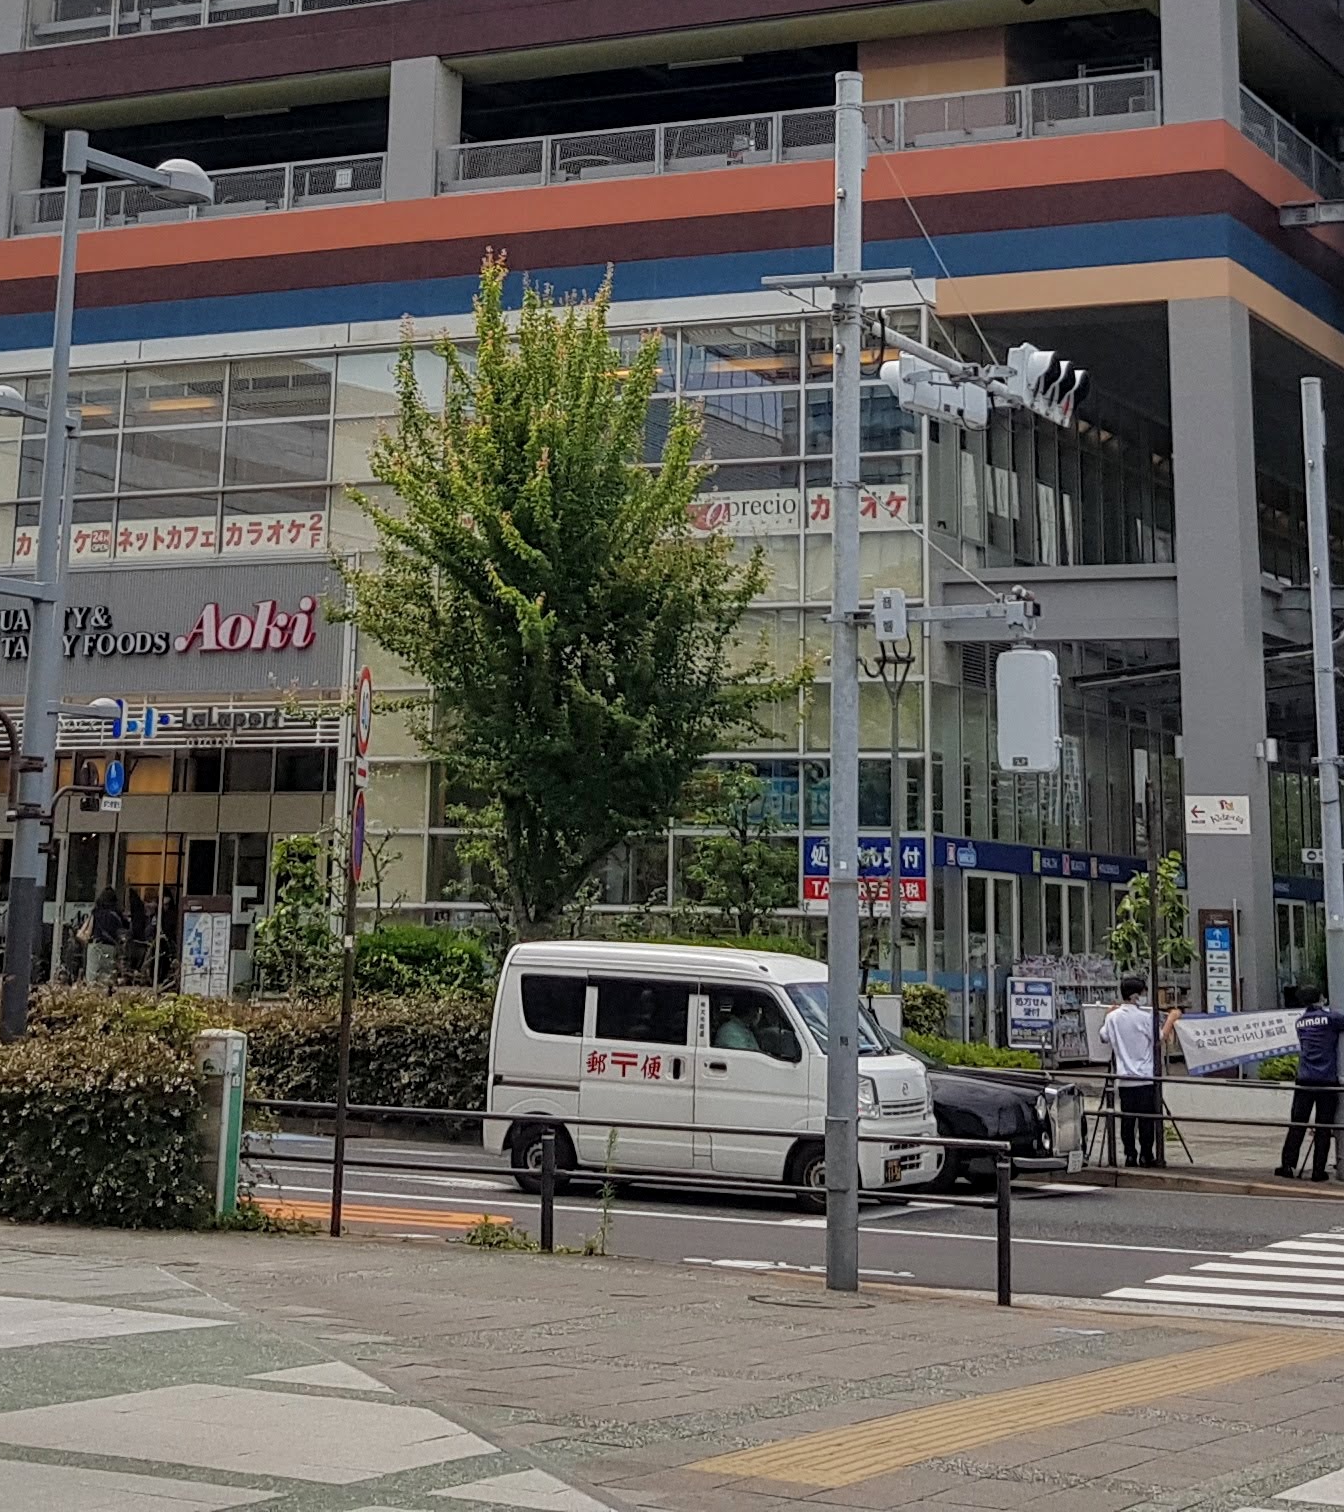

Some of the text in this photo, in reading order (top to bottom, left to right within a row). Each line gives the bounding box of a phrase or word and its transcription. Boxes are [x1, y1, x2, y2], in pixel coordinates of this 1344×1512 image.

[810, 490, 908, 521] カオケ
[117, 525, 216, 553] ネットカフェ
[225, 519, 306, 548] カラオケ
[173, 595, 318, 655] Aoki
[1, 631, 170, 658] TAY FOODS
